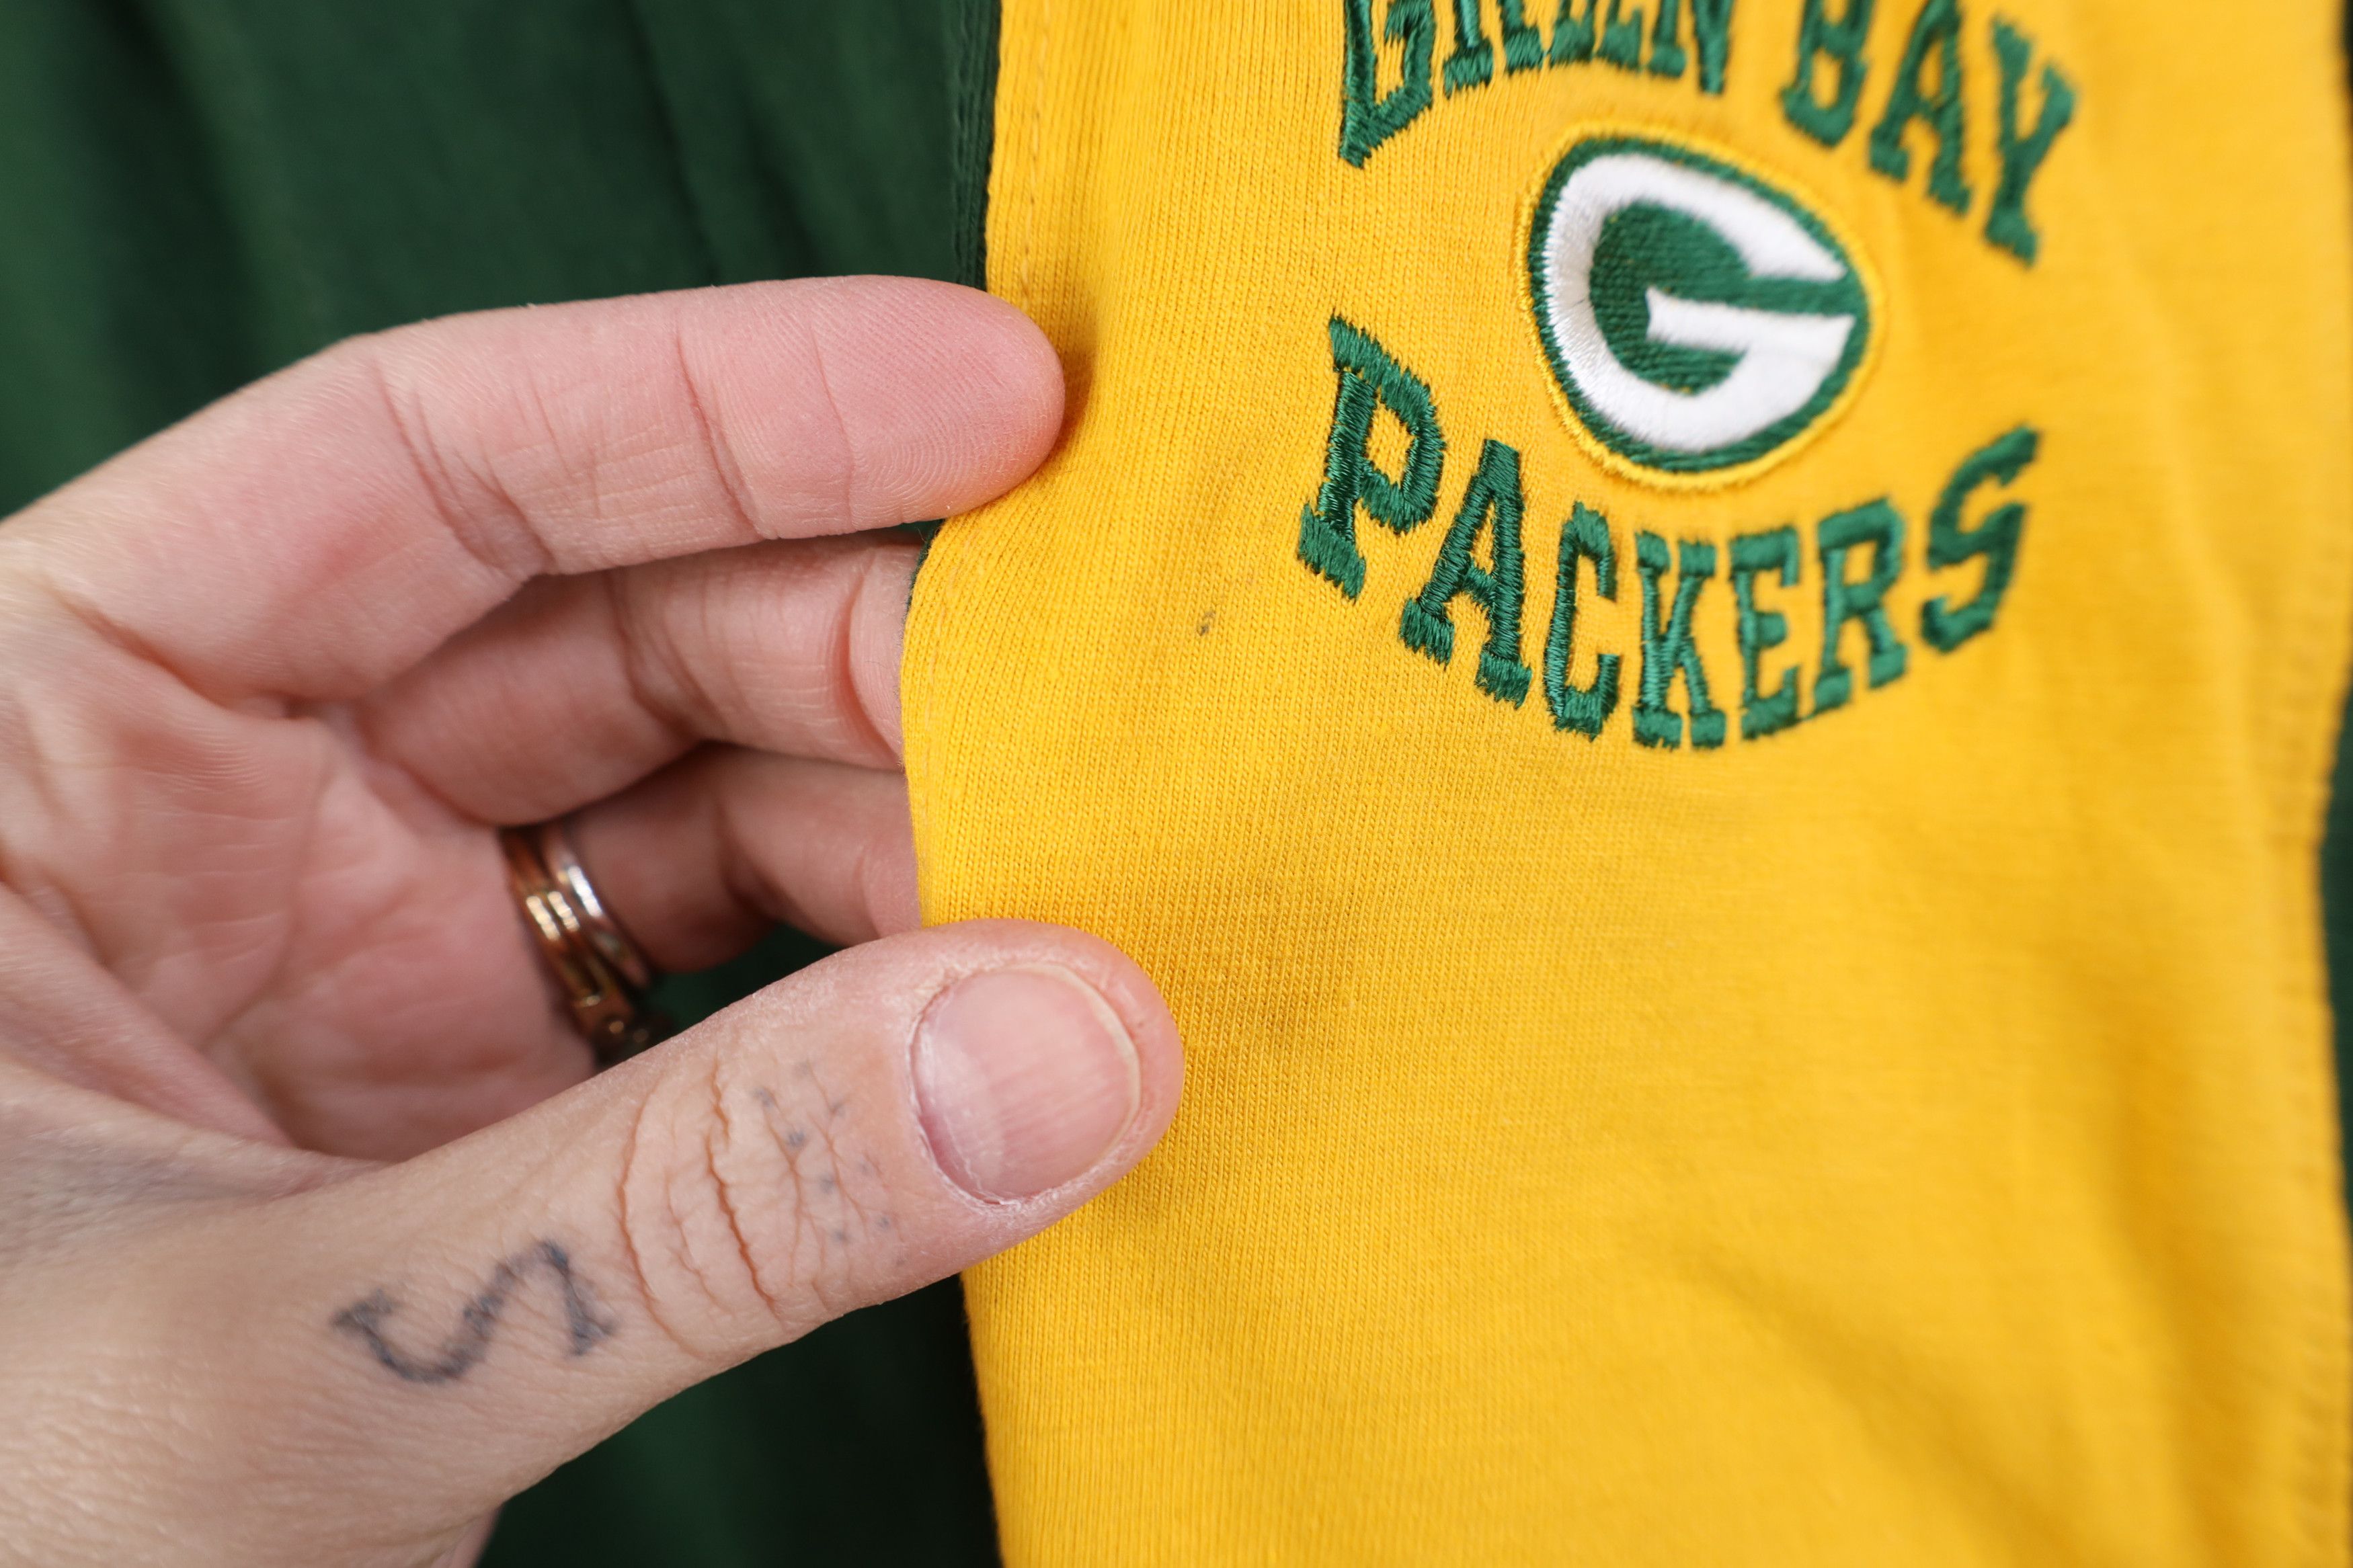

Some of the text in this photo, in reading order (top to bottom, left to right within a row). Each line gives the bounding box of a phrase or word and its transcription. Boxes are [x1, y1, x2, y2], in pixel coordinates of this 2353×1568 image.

[1778, 0, 2075, 266] BAY
[1542, 151, 1853, 452] G
[1298, 315, 2040, 749] PACKERS
